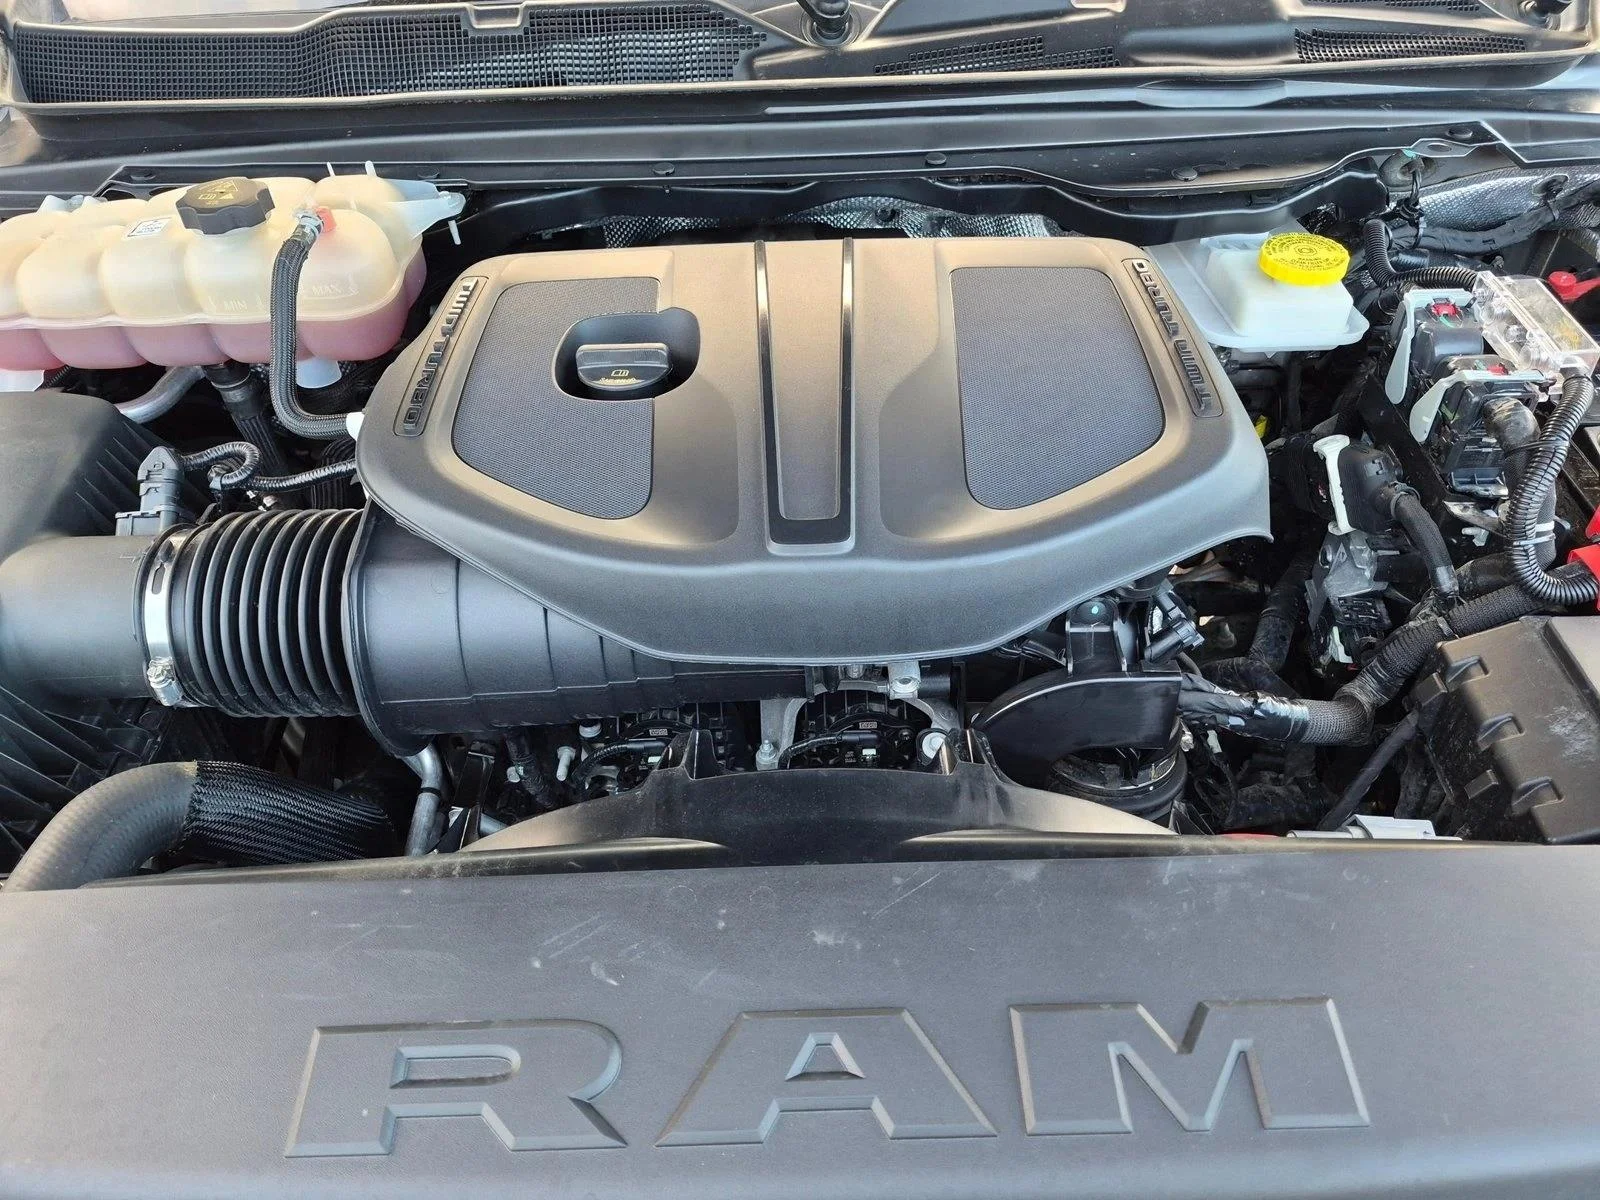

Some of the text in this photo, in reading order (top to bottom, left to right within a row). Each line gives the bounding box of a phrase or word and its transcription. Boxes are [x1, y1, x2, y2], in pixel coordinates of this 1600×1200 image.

[224, 299, 248, 311] MIN
[312, 284, 341, 296] MAX
[403, 278, 479, 431] TWIN TURBO
[1132, 260, 1212, 411] TWIN TURBO
[285, 996, 1371, 1158] RAM
